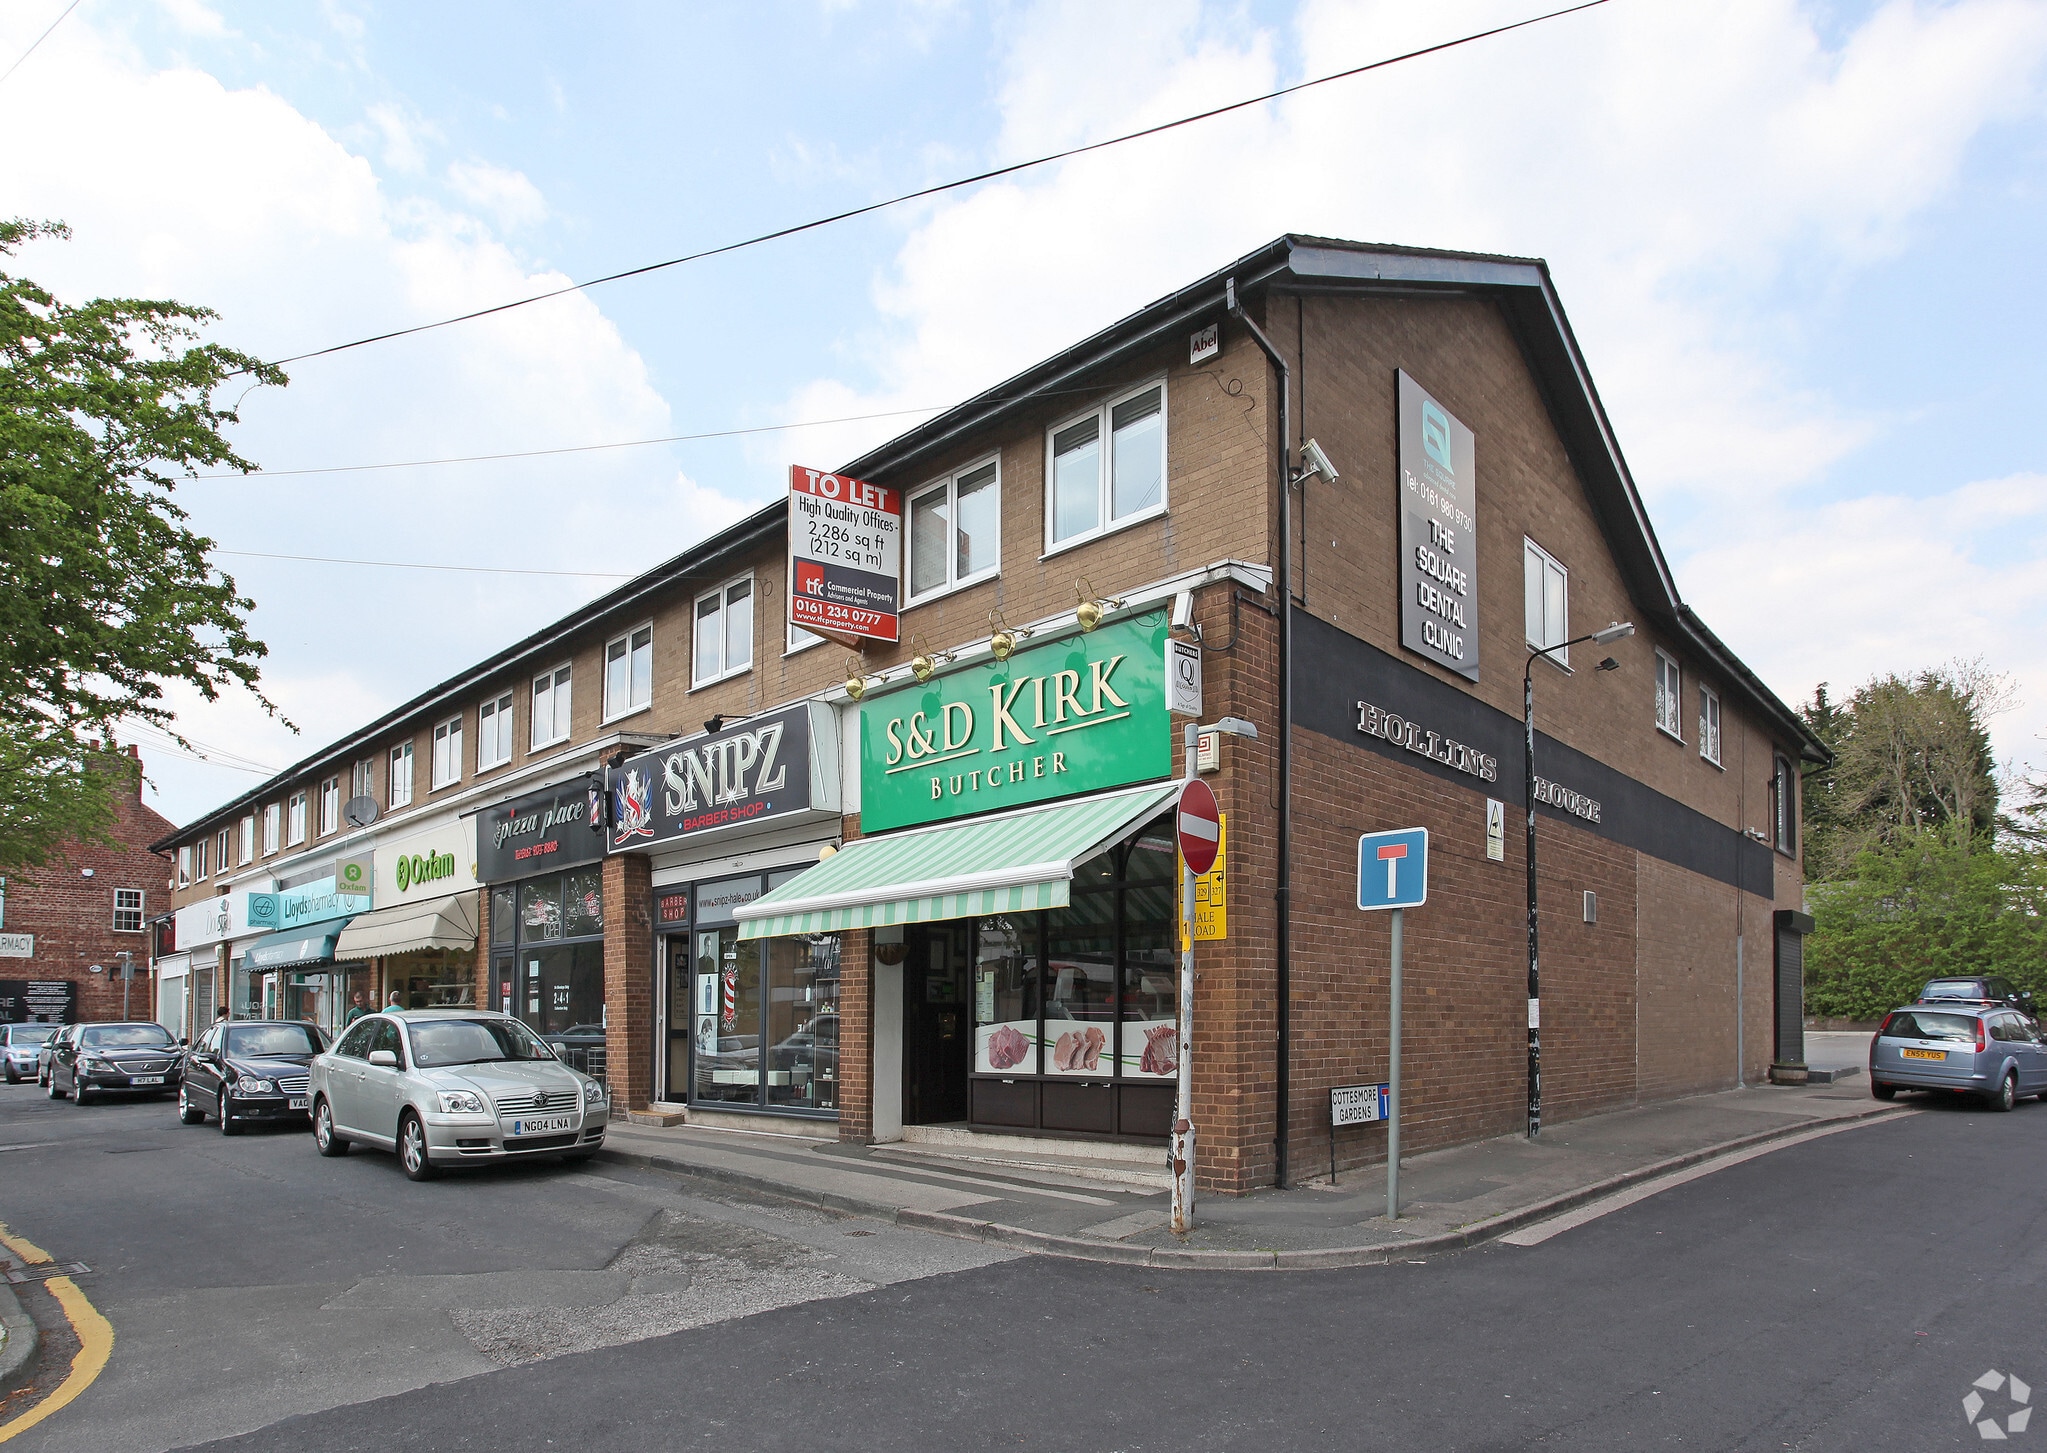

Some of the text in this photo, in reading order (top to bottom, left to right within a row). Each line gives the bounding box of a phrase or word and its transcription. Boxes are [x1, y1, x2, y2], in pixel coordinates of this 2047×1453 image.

[1192, 331, 1217, 355] Abel
[805, 469, 888, 510] TO LET
[1405, 469, 1472, 532] Tel: 0161 980 9730
[799, 495, 821, 518] High
[825, 502, 859, 527] Quality
[863, 511, 893, 532] Offices
[808, 520, 884, 551] 2,286 sq ft
[1430, 517, 1455, 555] THE
[810, 537, 882, 570] (212 sq m)
[1418, 545, 1467, 596] SQUARE
[806, 578, 824, 596] tfc
[827, 581, 893, 604] Commercial Property
[796, 599, 881, 625] 0161 234 0777
[1420, 581, 1467, 629] DENTAL
[796, 612, 870, 632] www.tfcproperty.com
[1175, 644, 1198, 658] BUTCHERS
[1425, 620, 1464, 661] CLINIC
[885, 655, 1129, 766] S&D KIRK
[664, 721, 786, 818] SNIPZ
[930, 752, 1067, 800] BUTCHER
[1357, 700, 1600, 824] HOLLINS HOUSE
[496, 796, 584, 849] pizza place
[683, 802, 764, 831] BARBER SHOP
[411, 849, 454, 884] Oxfam
[339, 882, 367, 892] Oxfam
[660, 895, 688, 908] BARBER
[1197, 887, 1221, 897] 329 327
[284, 892, 340, 922] Lloydspharmacy
[663, 908, 685, 919] SHOP
[1194, 925, 1216, 936] OAD
[1332, 1088, 1377, 1105] COTTESMORE
[524, 1118, 569, 1132] NG04 LNA
[1340, 1106, 1372, 1122] GARDENS
